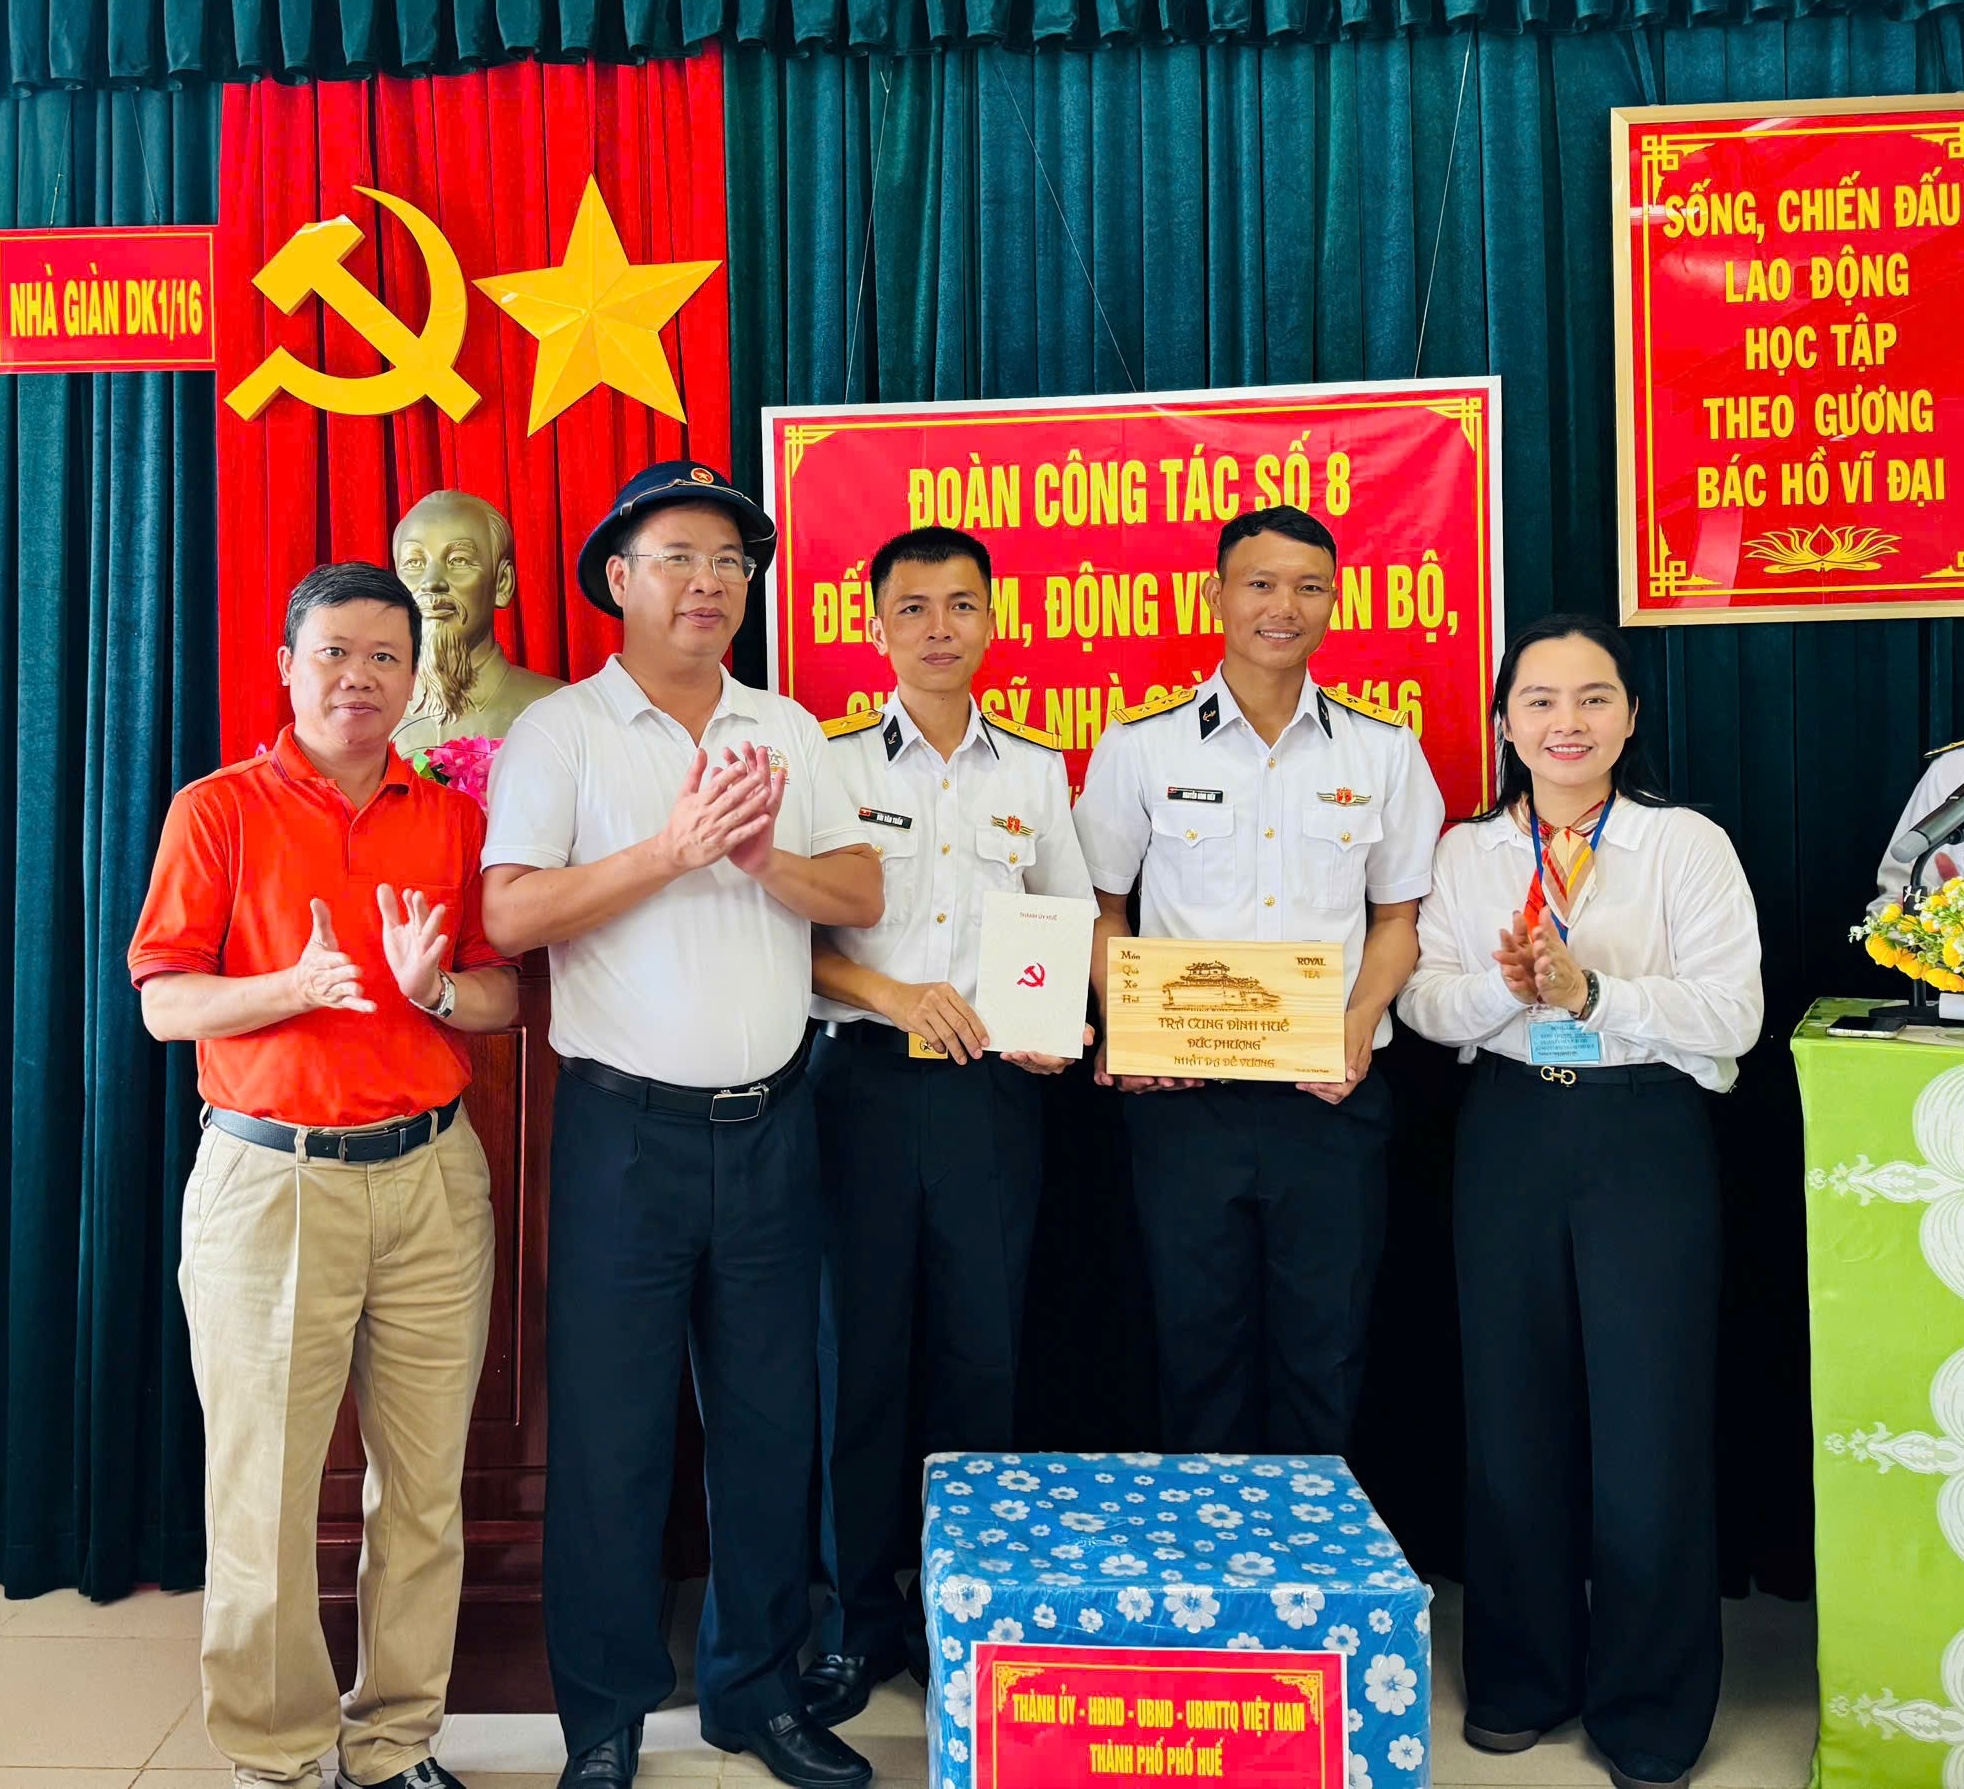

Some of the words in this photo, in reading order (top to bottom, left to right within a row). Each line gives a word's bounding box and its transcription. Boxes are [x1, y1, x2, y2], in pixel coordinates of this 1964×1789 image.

[1662, 178, 1765, 243] SỐNG,
[1777, 171, 1880, 233] CHIẾN
[1894, 166, 1961, 228] ĐẤU
[10, 263, 58, 337] NHÀ
[63, 262, 119, 337] GIÀN
[125, 278, 203, 342] DK1/16
[1725, 257, 1792, 303] LAO
[1810, 244, 1910, 306] ĐỘNG
[1745, 325, 1818, 377] HỌC
[1831, 312, 1897, 372] TẬP
[1703, 394, 1795, 441] THEO
[1814, 385, 1934, 436] GƯƠNG
[908, 452, 1021, 531] ĐOÀN
[1034, 448, 1147, 528] CÔNG
[1160, 443, 1240, 523] TÁC
[1254, 430, 1311, 513] SỐ
[1325, 451, 1350, 516] 8
[1697, 453, 1767, 509] BÁC
[1781, 446, 1829, 506] HỒ
[1841, 451, 1874, 504] VĨ
[1887, 458, 1946, 508] ĐẠI
[1045, 561, 1159, 652] ĐỘNG
[1387, 549, 1458, 643] BỘ,
[1296, 957, 1326, 966] ROYAL
[1303, 970, 1321, 979] TEA
[1187, 1018, 1224, 1030] CUNG
[1012, 1688, 1056, 1724] THÀNH
[1059, 1683, 1077, 1725] ỦY
[1137, 1698, 1174, 1729] UBND
[1186, 1699, 1240, 1735] UBMTTQ
[1241, 1695, 1271, 1738] VIỆT
[1273, 1702, 1306, 1732] NAM
[1089, 1738, 1134, 1774] THÀNH
[1136, 1735, 1165, 1775] PHỐ
[1167, 1736, 1195, 1776] PHỐ
[1197, 1736, 1224, 1777] HUẾ
